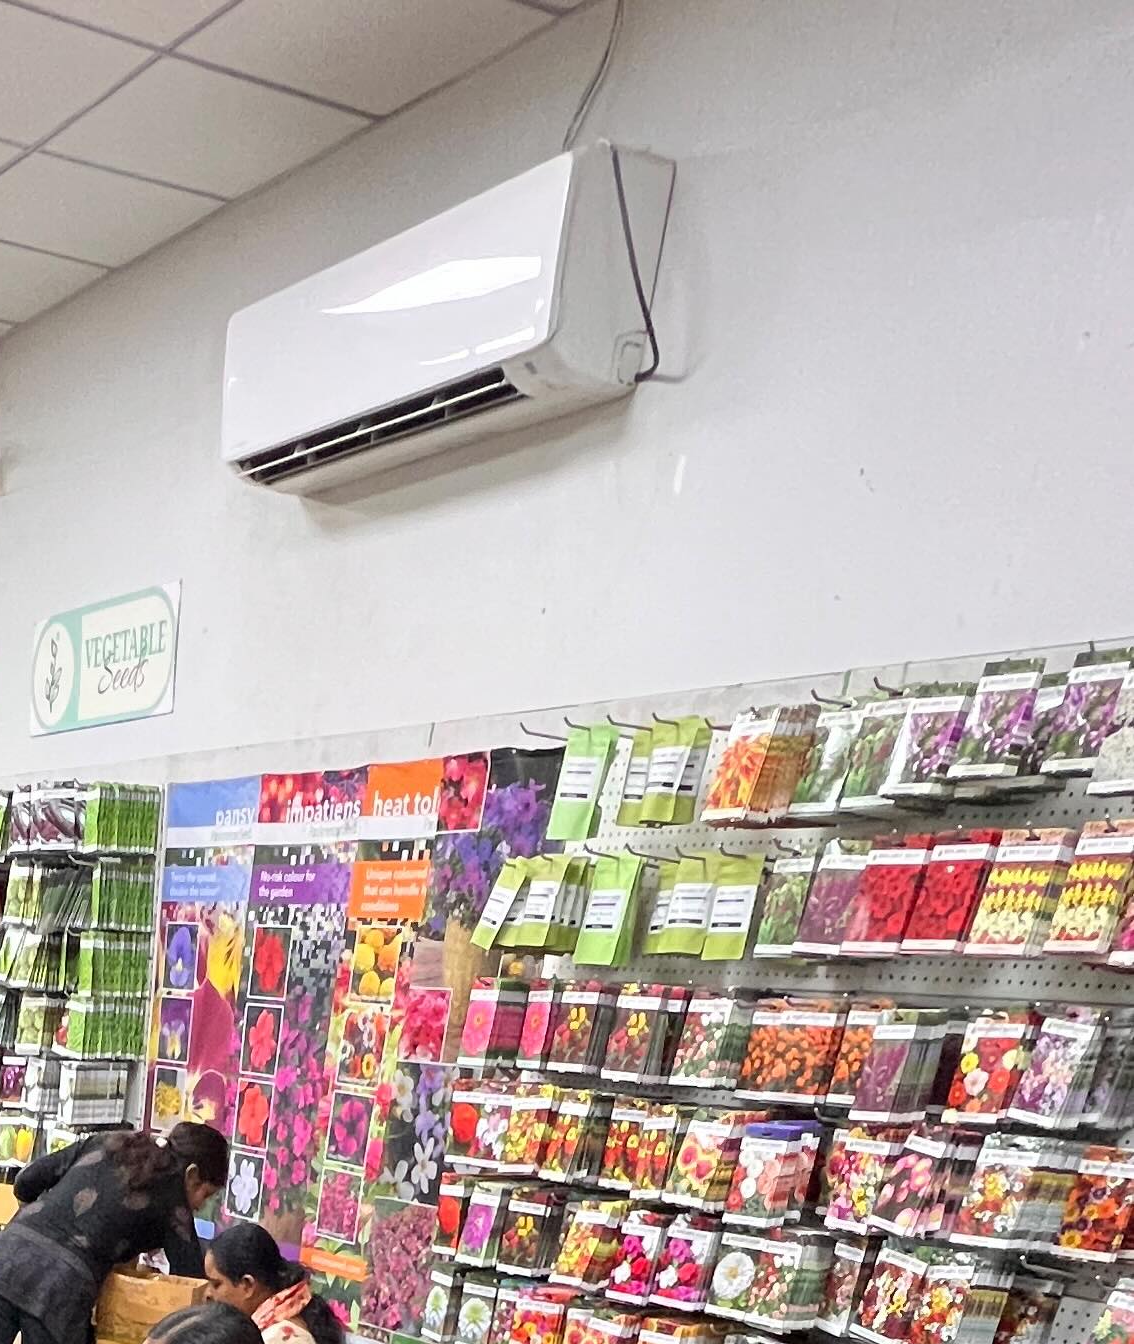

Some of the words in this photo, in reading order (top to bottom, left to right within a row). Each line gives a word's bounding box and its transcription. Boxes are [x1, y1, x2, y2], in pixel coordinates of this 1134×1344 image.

[85, 619, 168, 668] VEGETABLE
[97, 645, 149, 694] Seeds
[285, 798, 362, 824] impatiens
[372, 790, 410, 816] heat
[215, 807, 255, 826] pansy
